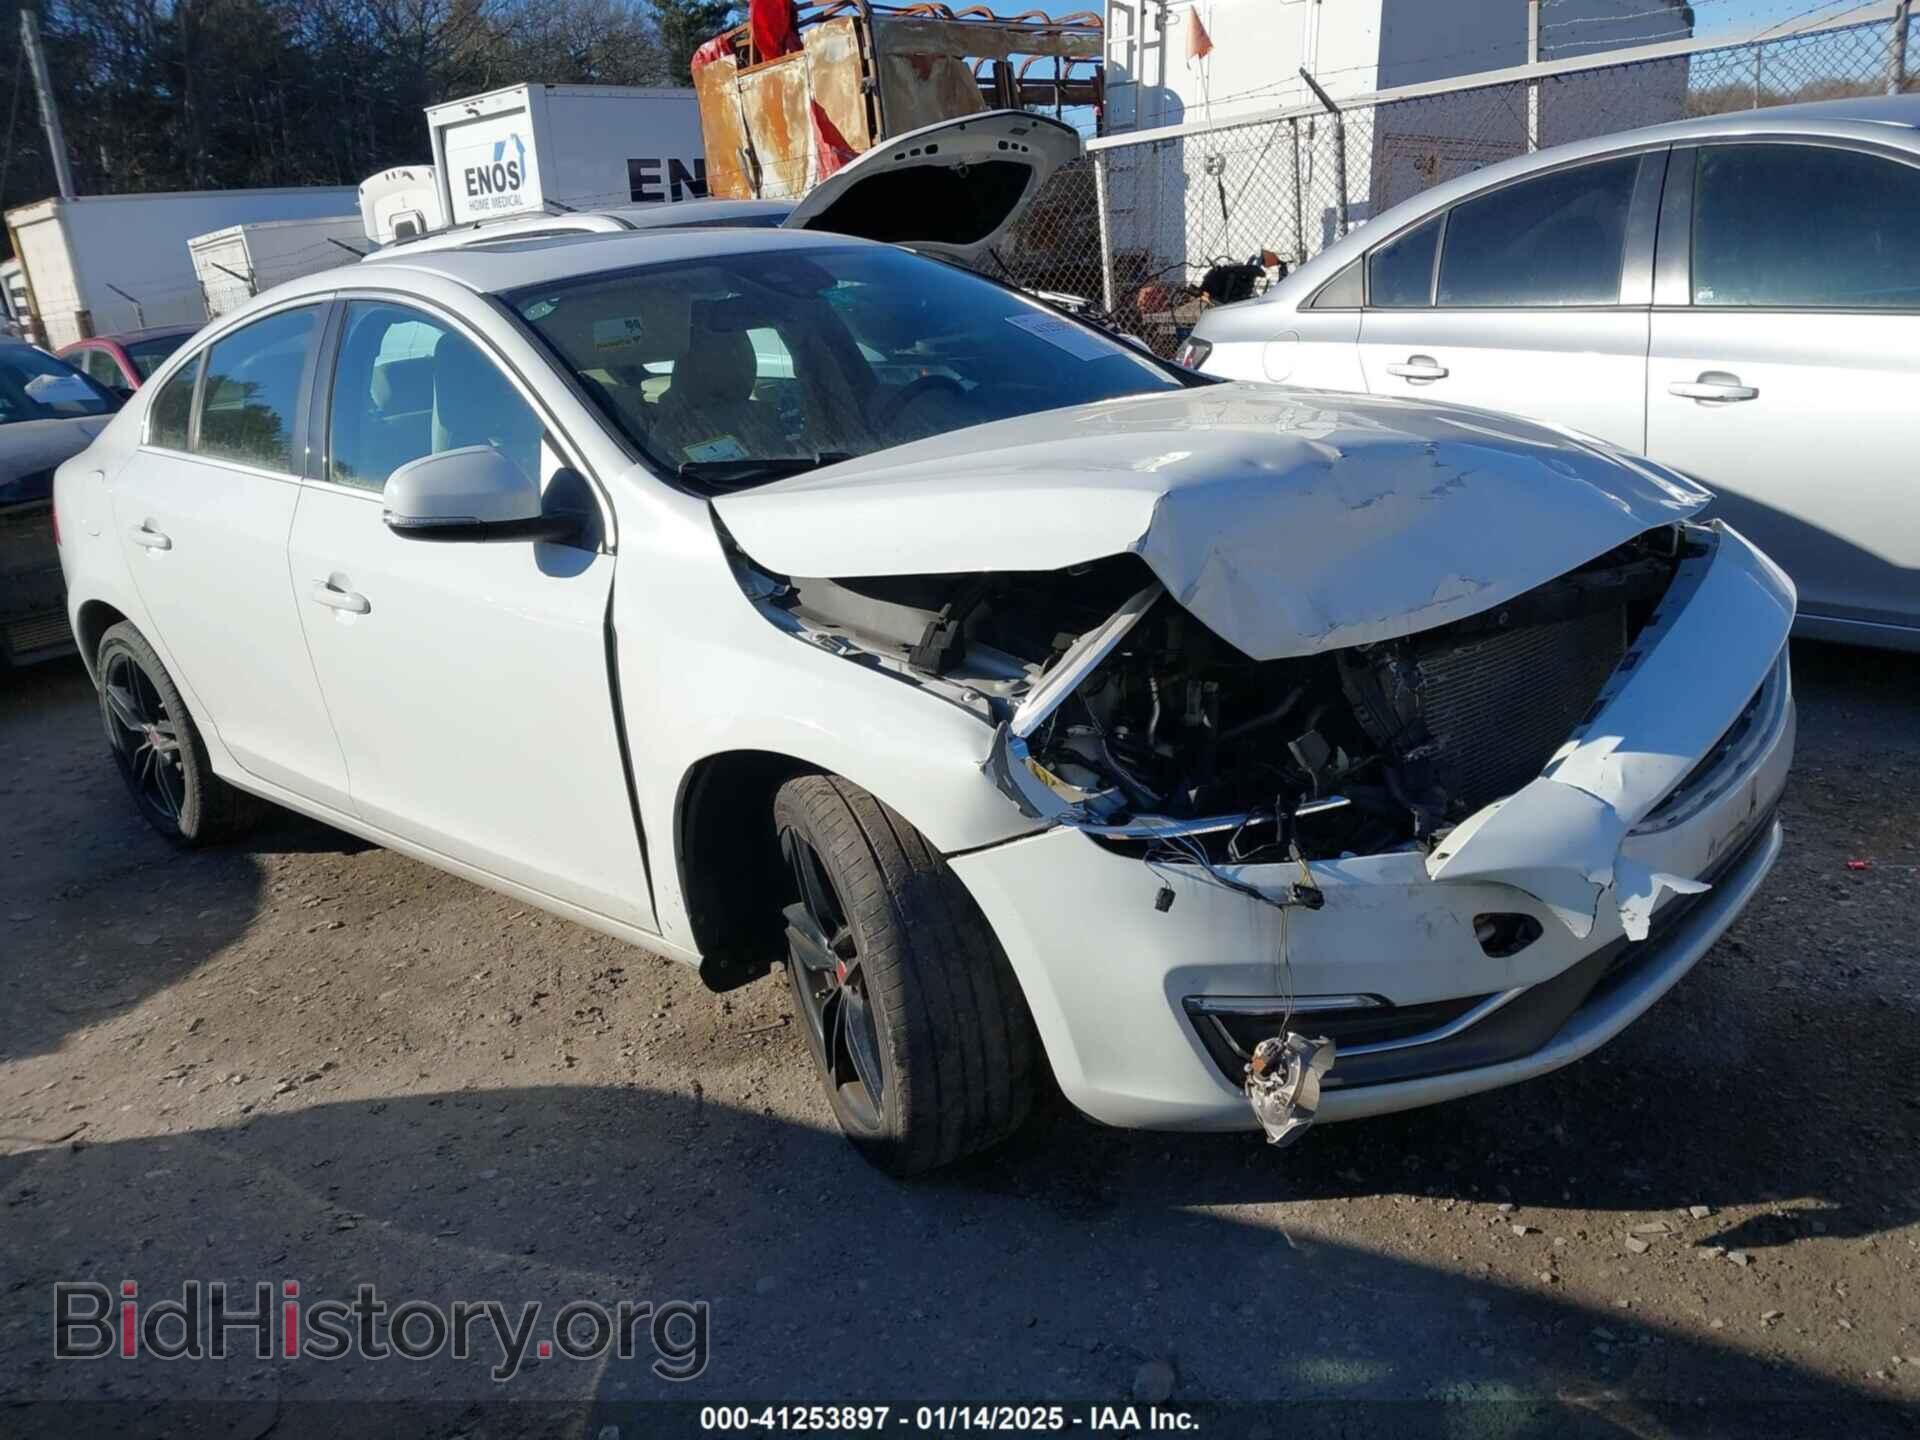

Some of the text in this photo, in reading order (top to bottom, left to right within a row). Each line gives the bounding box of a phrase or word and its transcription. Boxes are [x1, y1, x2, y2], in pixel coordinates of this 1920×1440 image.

[464, 160, 521, 197] ENOS
[468, 194, 524, 211] HOME MEDICAL
